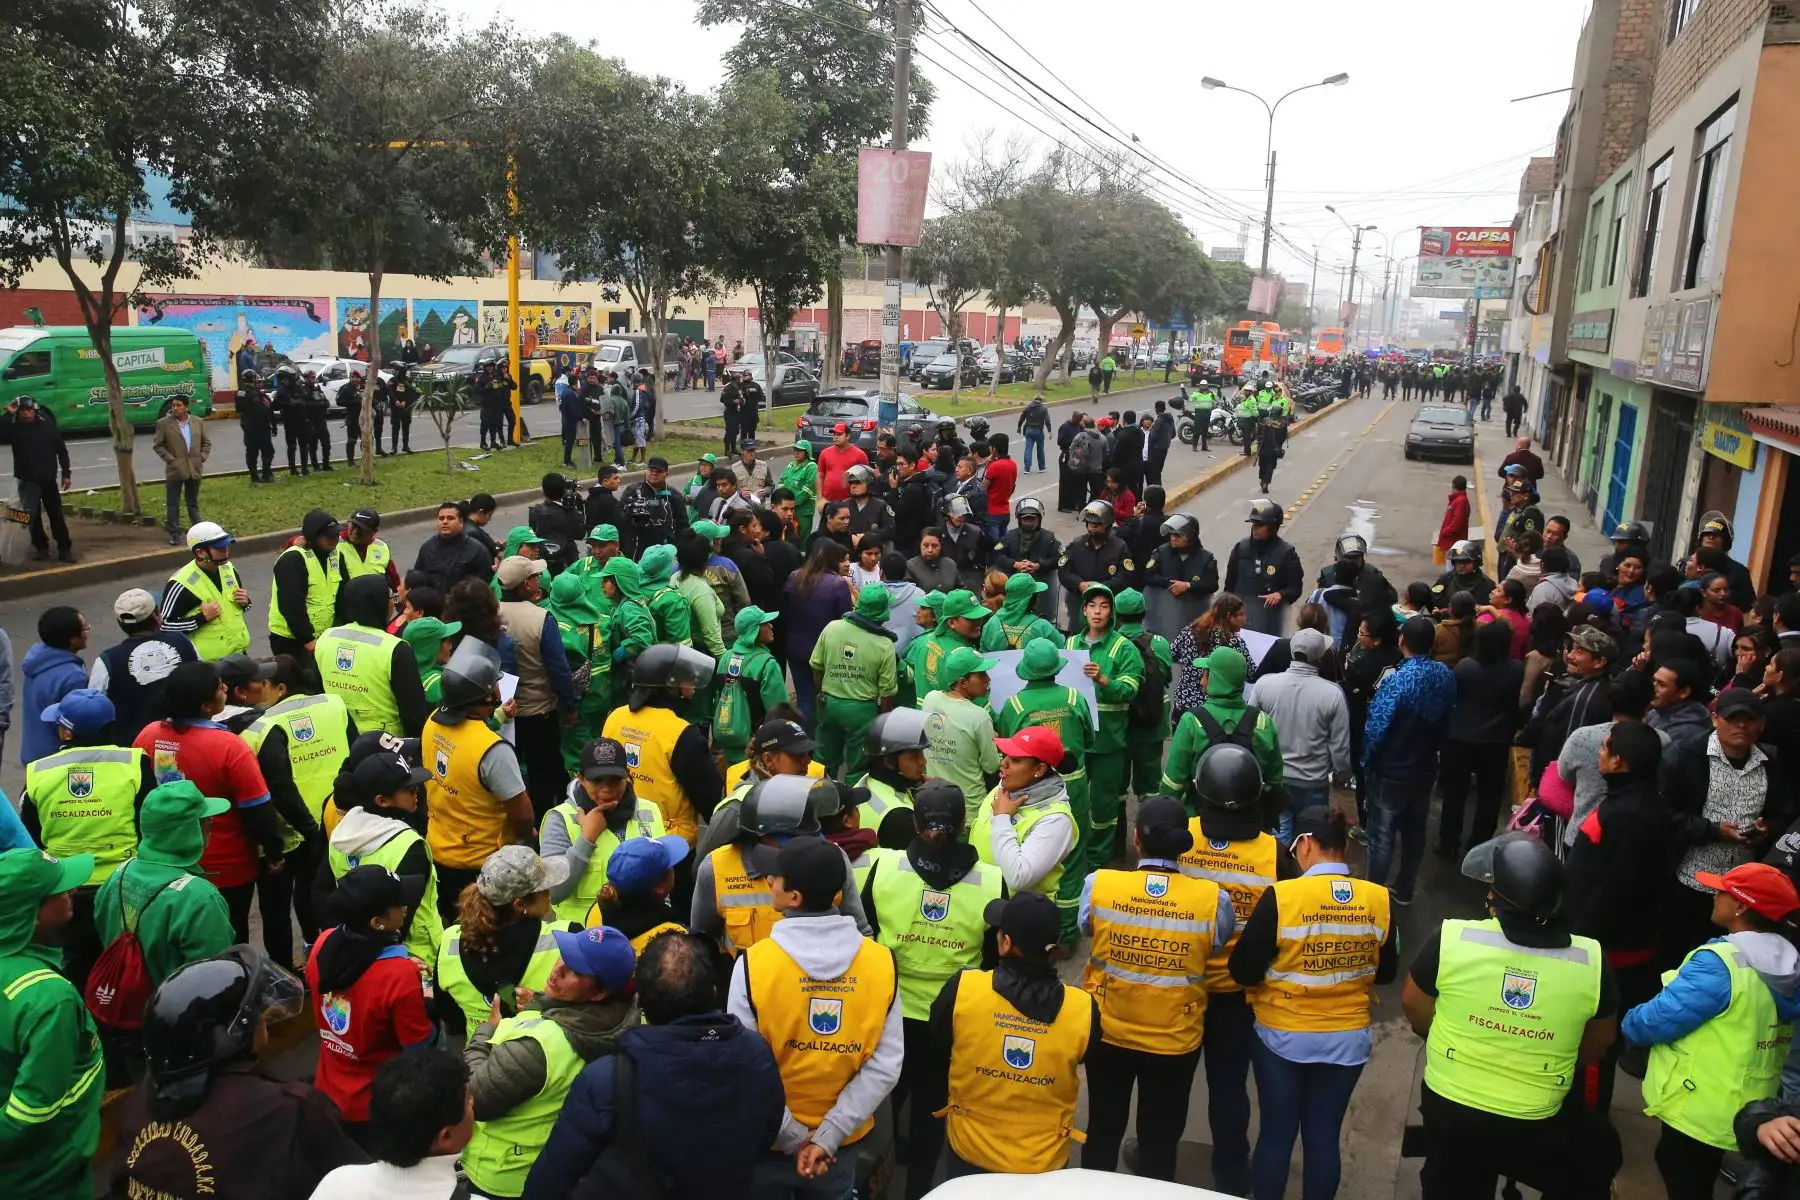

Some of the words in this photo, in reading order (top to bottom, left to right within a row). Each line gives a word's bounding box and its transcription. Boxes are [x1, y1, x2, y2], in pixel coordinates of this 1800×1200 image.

[1455, 231, 1510, 242] CAPSA
[117, 353, 159, 367] CAPITAL
[292, 745, 337, 763] CALIZACIÓN
[50, 808, 112, 818] FISCALIZACIÓN
[1130, 896, 1169, 907] Municipalidad
[1112, 900, 1195, 920] Independencia
[896, 934, 965, 949] FISCALIZACIÓN
[1109, 931, 1190, 953] INSPECTOR
[1302, 940, 1377, 954] INSPECTOR
[1110, 948, 1186, 968] MUNICIPAL
[995, 1021, 1048, 1035] INDEPENDENCIA
[1468, 1014, 1555, 1041] FISCALIZACIÓN
[784, 1039, 862, 1054] FISCALIZACIÓN
[975, 1066, 1056, 1086] FISCALIZACIÓN
